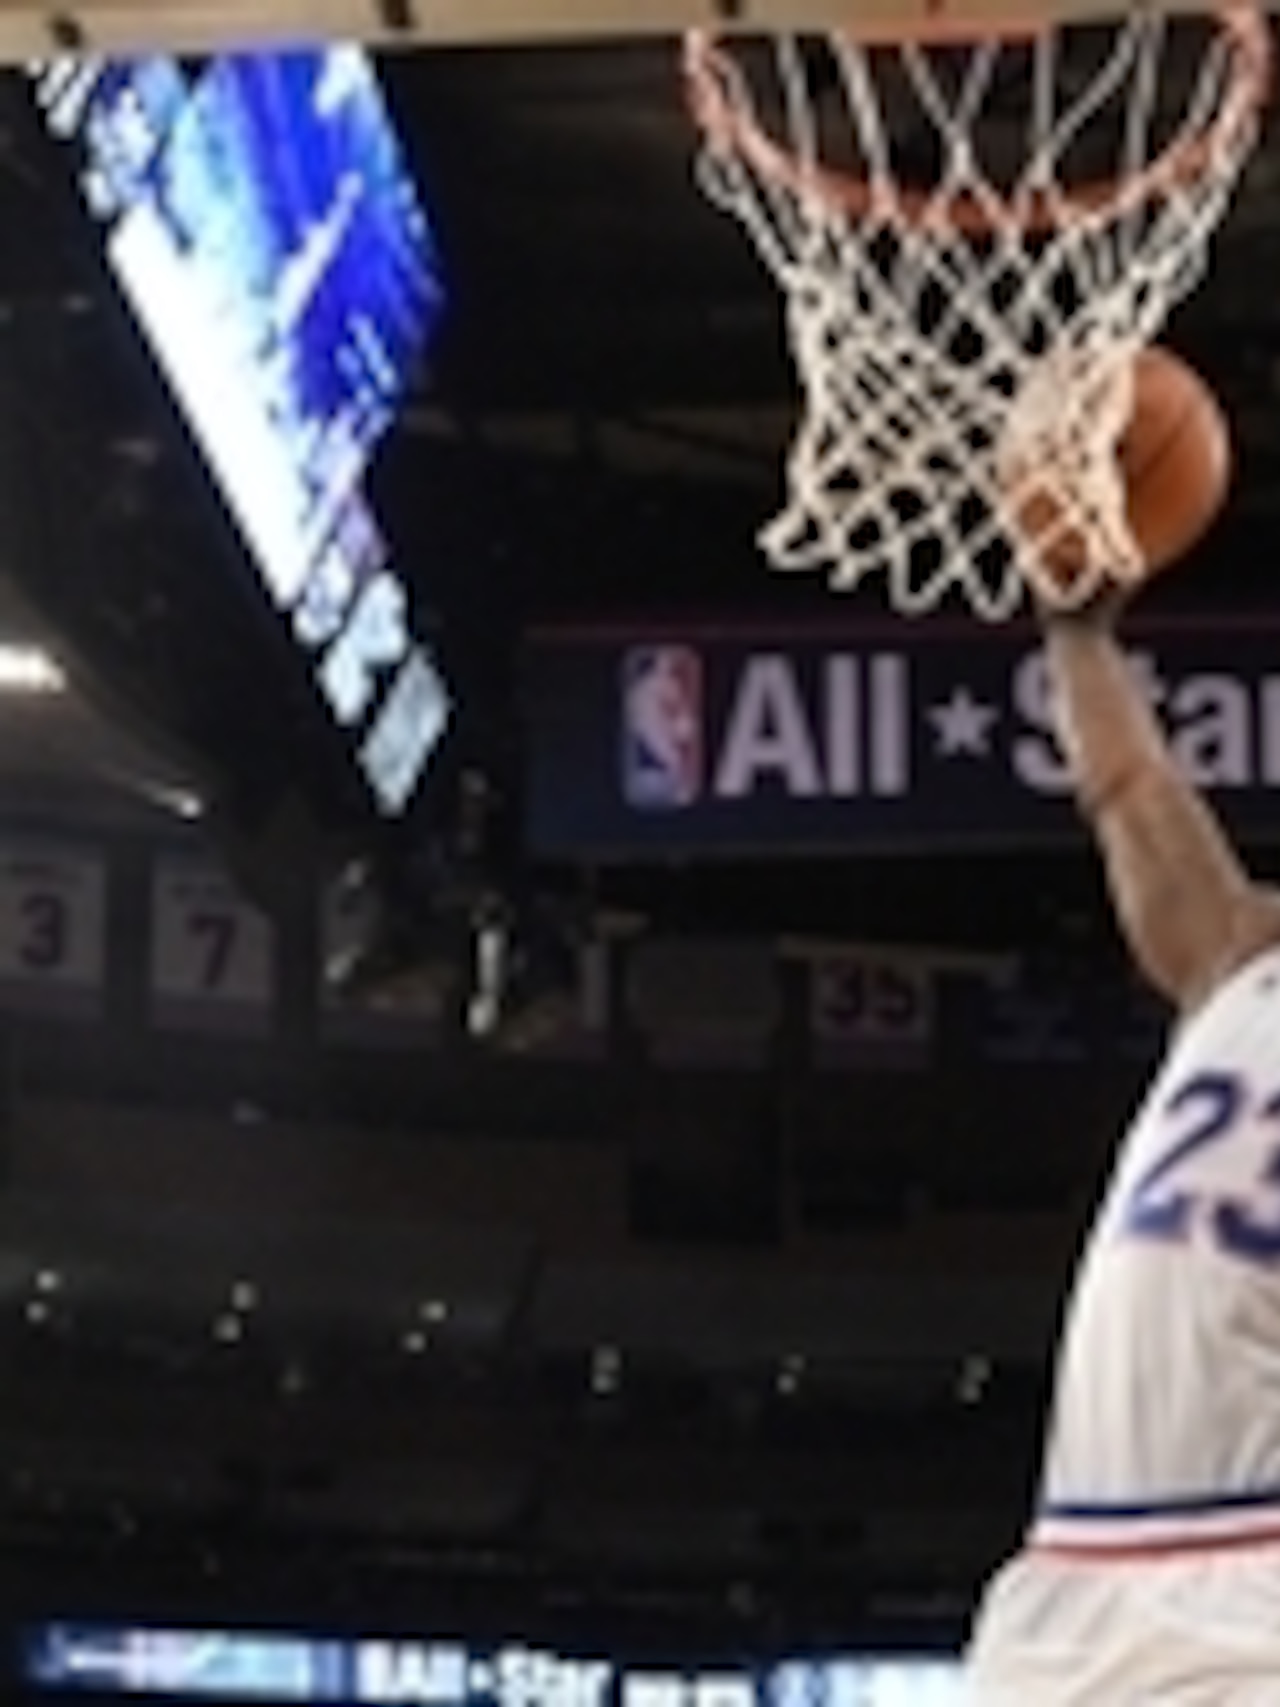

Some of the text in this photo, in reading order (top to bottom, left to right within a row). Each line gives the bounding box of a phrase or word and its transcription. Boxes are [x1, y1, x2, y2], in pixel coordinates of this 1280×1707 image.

[712, 652, 909, 796] All
[19, 892, 65, 969] 3
[186, 912, 238, 988] 7
